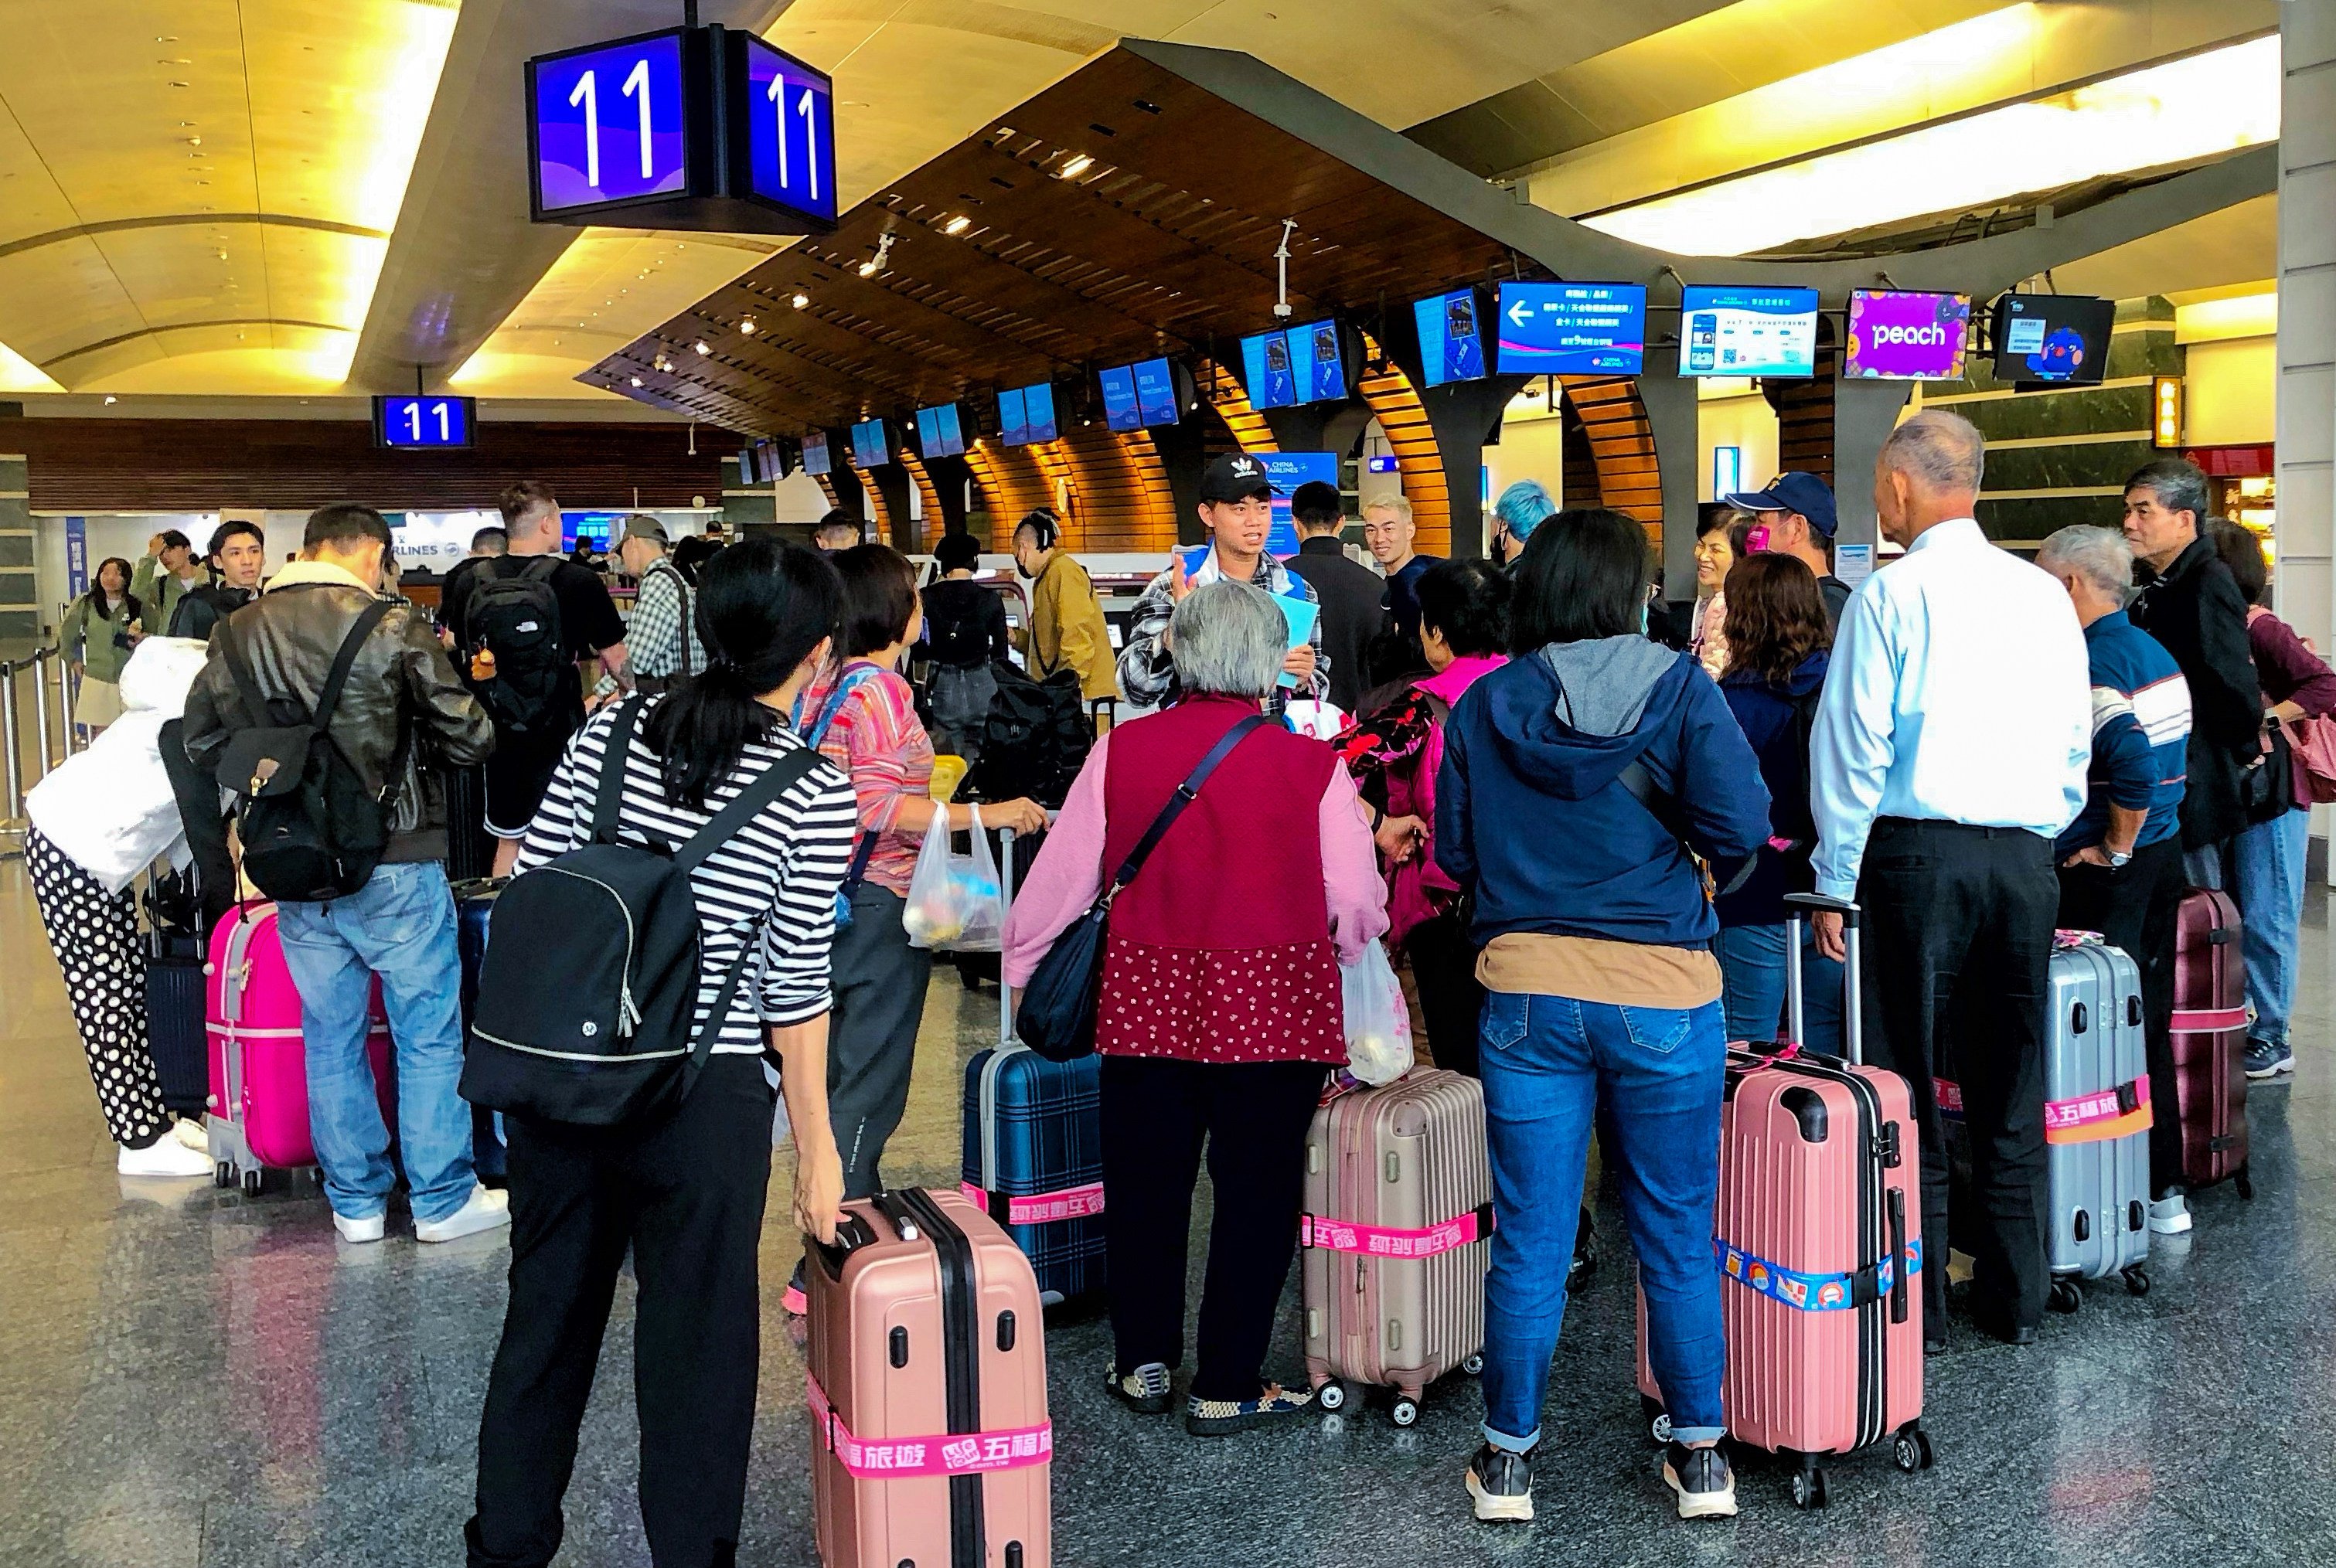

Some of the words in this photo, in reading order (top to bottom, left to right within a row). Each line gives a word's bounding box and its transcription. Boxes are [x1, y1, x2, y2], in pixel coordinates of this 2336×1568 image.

[568, 59, 653, 188] 11
[767, 73, 818, 200] 11
[1871, 321, 1946, 350] peach
[403, 402, 449, 441] 11
[1234, 470, 1258, 478] adidas
[392, 545, 438, 556] RLINES
[1368, 1232, 1446, 1256] 五福旅遊
